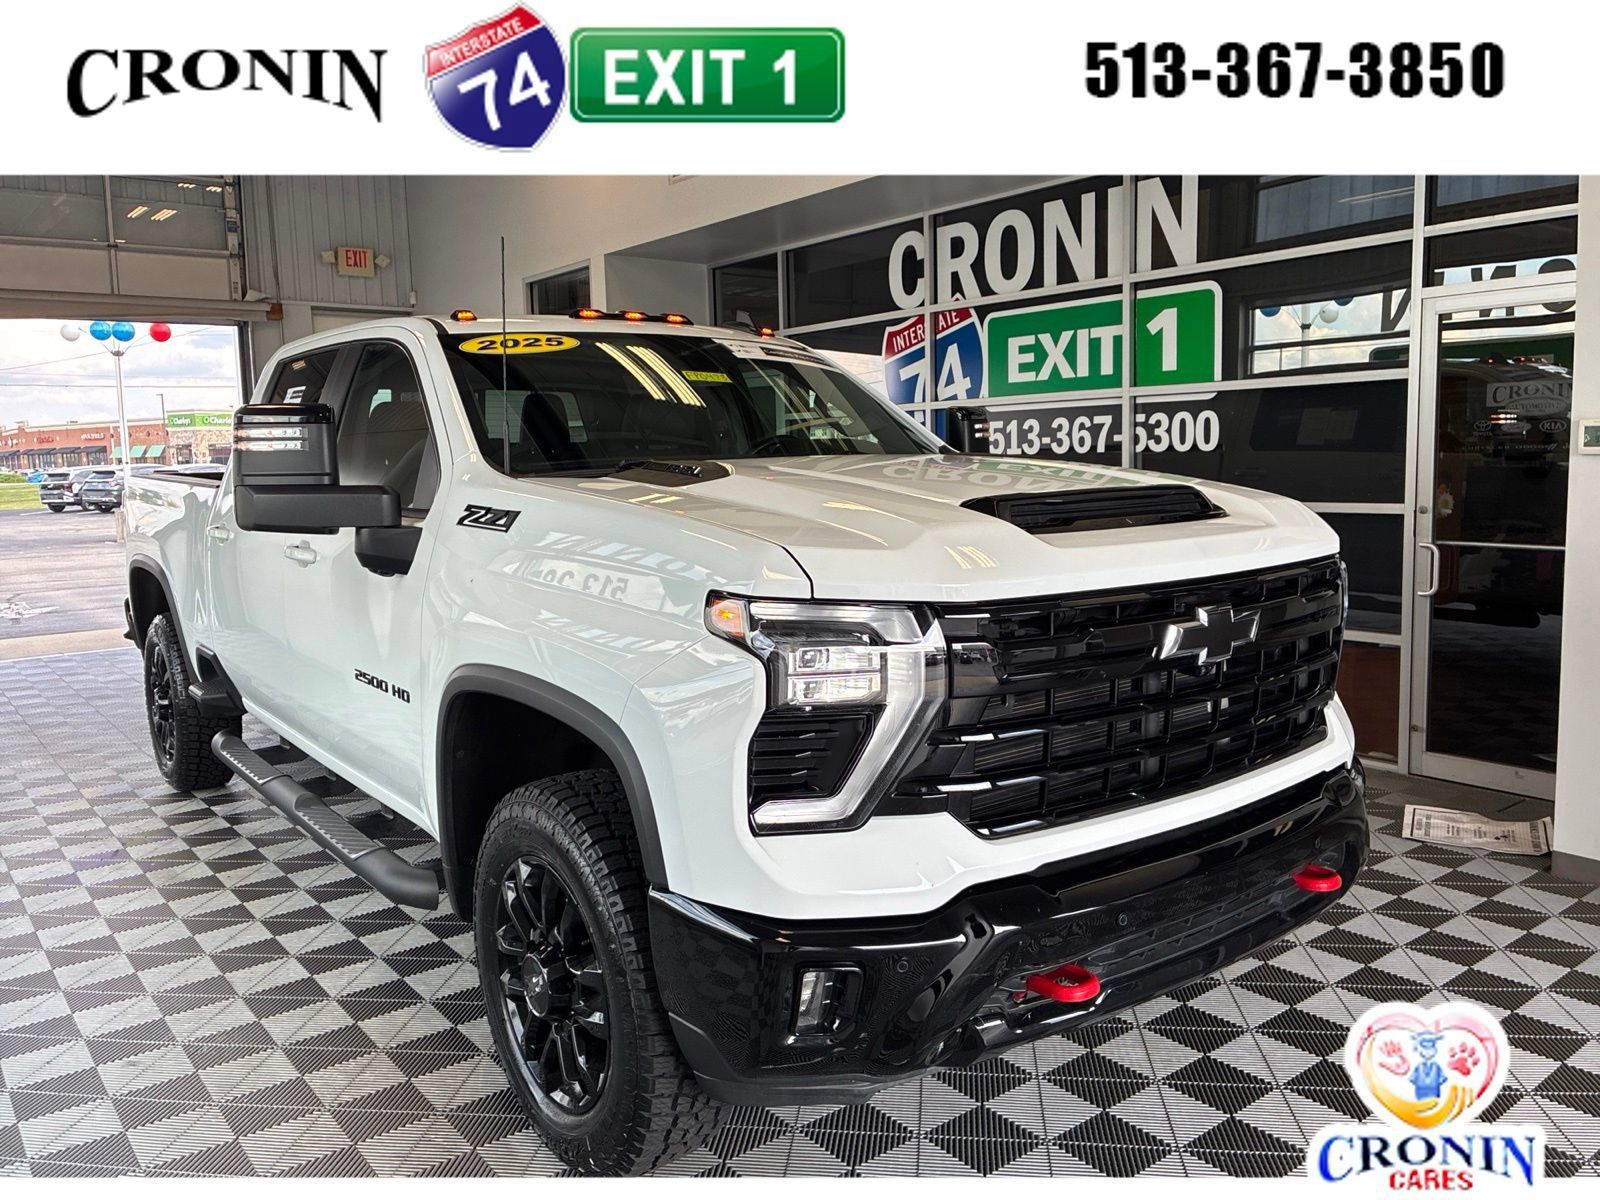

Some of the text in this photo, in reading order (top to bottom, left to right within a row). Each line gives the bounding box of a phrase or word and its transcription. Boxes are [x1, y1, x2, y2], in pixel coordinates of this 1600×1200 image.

[344, 250, 369, 269] EXIT
[888, 175, 1198, 311] CRONIN
[476, 336, 565, 351] 2025
[1007, 307, 1178, 384] EXIT 1
[899, 342, 972, 423] 74
[989, 410, 1220, 455] 513-367-5300
[1543, 421, 1563, 430] KIA
[456, 503, 522, 533] Z71
[354, 668, 411, 704] 2500 HD
